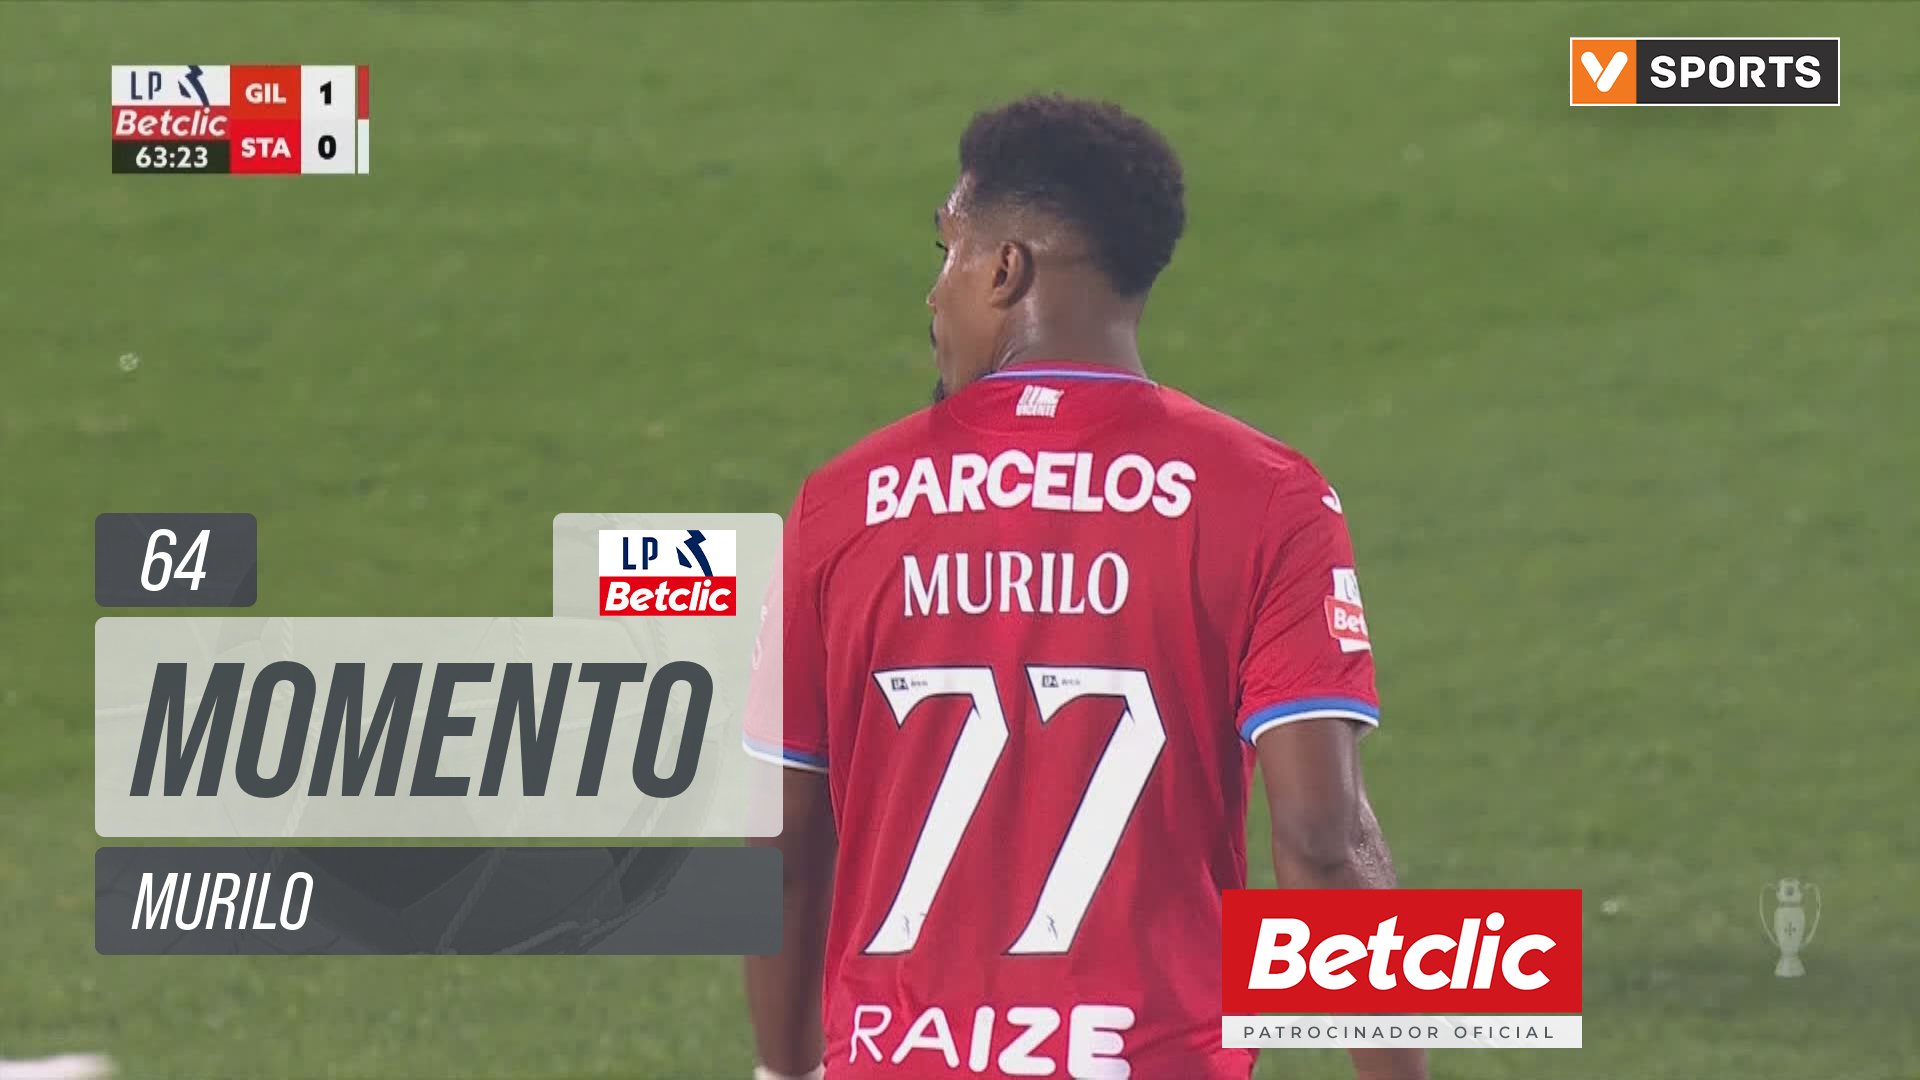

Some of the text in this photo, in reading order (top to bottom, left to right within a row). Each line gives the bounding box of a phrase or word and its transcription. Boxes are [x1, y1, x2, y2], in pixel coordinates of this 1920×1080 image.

[865, 448, 1197, 526] BARCELOS
[902, 551, 1130, 617] MURILO
[863, 665, 1167, 955] 77
[849, 1004, 1136, 1080] RAIZE
